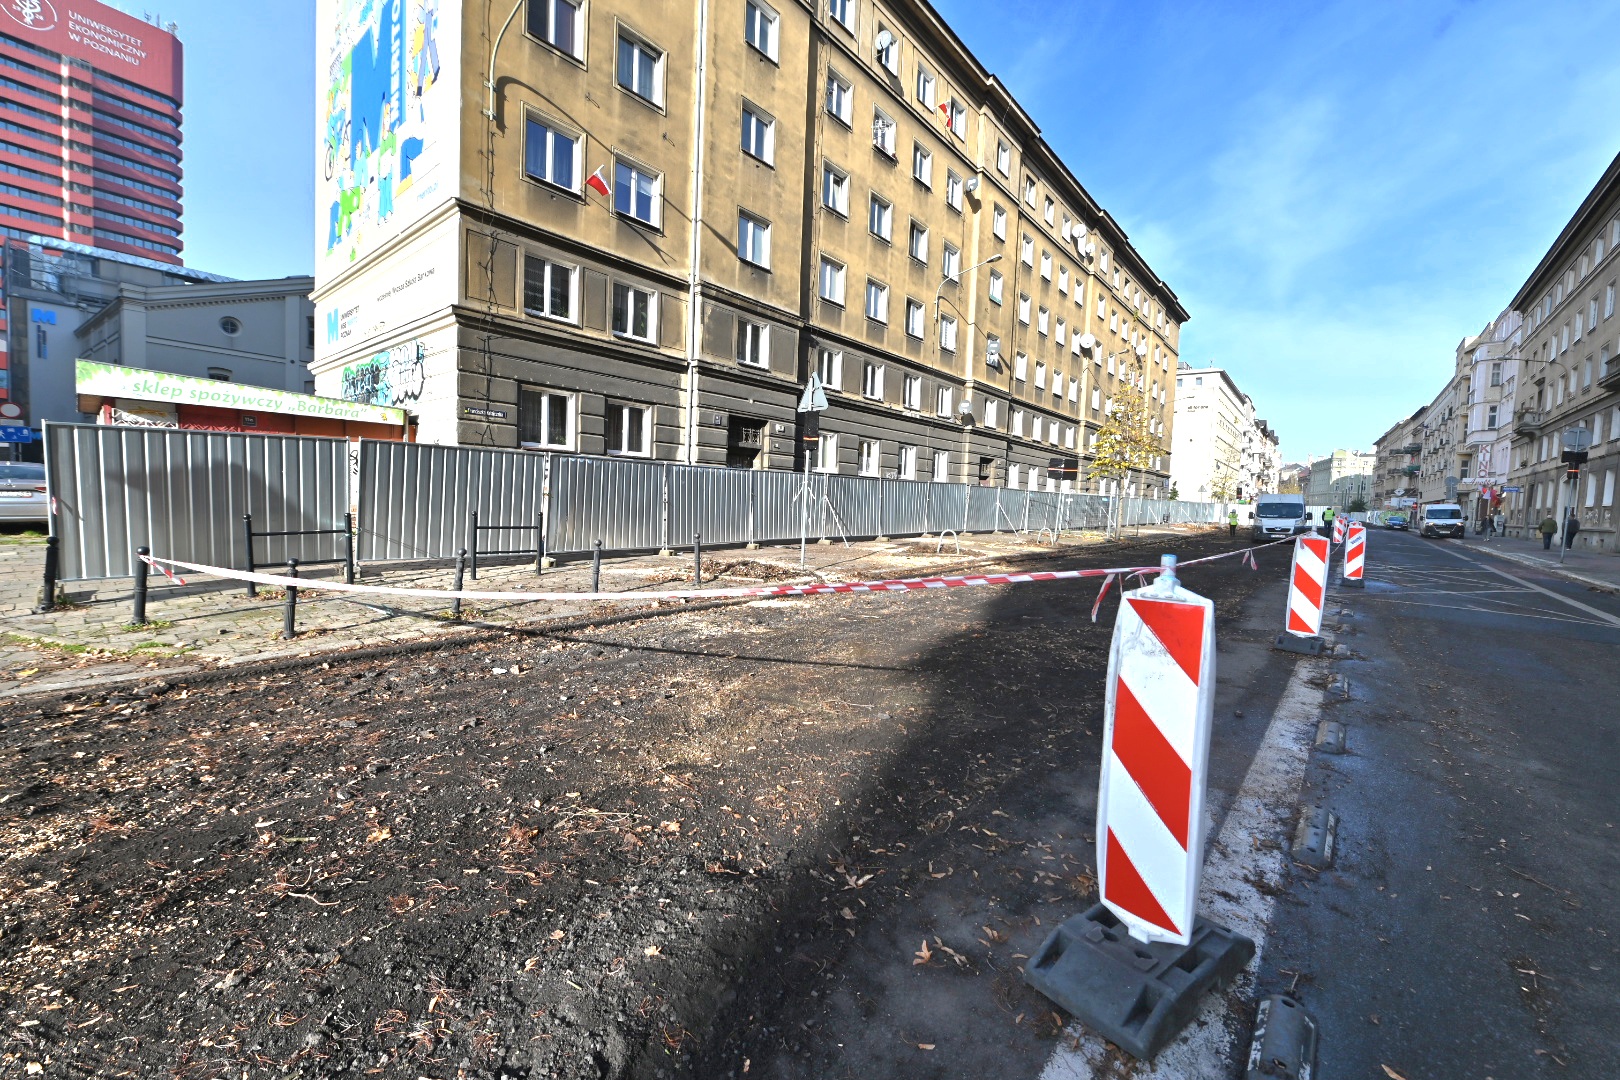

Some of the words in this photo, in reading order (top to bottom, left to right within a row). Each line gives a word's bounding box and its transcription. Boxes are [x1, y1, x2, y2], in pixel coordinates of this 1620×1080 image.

[68, 10, 142, 47] UNIWERSYTET
[68, 21, 147, 58] EKONOMICZNY
[69, 32, 81, 43] W
[83, 38, 139, 66] POZNANIU
[132, 379, 183, 399] sklep
[189, 389, 283, 409] spożywczy
[1478, 444, 1490, 478] KINO
